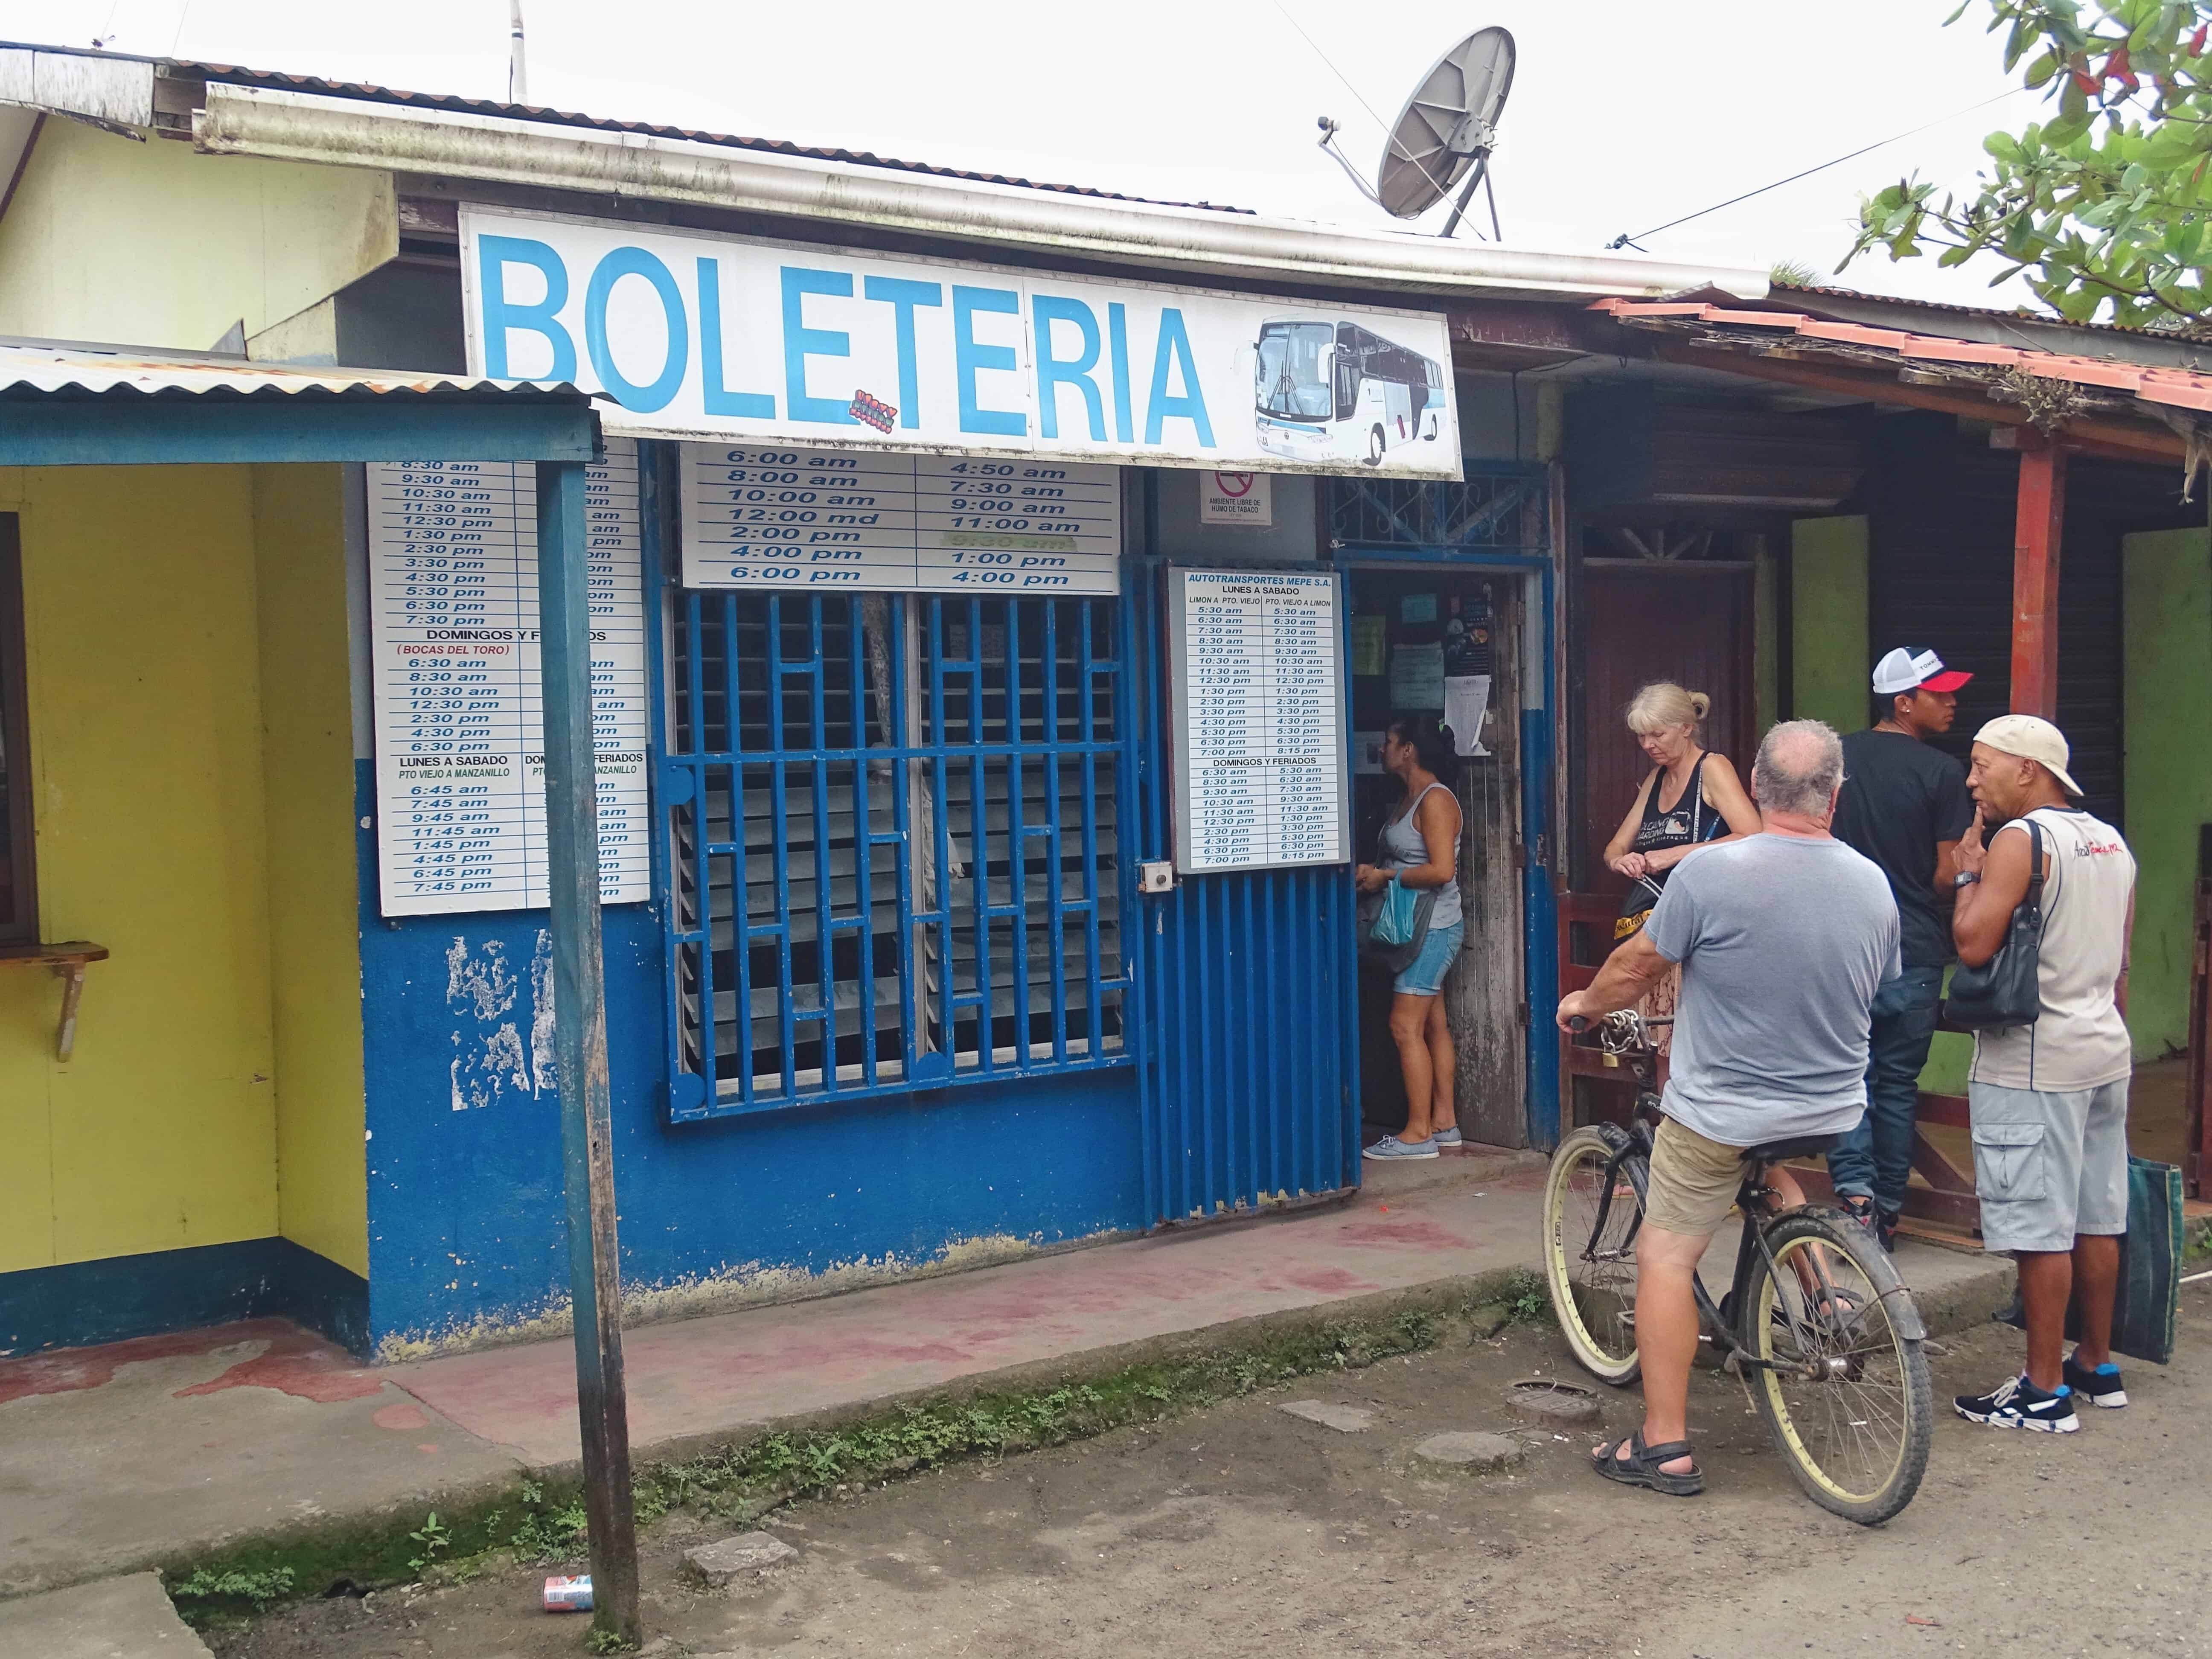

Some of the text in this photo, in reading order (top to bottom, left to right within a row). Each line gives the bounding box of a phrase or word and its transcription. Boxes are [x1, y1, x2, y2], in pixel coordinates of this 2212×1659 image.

[478, 234, 1217, 448] BOLETERIA
[727, 451, 857, 468] 6:00 am
[951, 463, 1065, 479] 4:50 am
[402, 474, 444, 484] 9:30
[728, 470, 858, 486] 8:00 am
[403, 488, 455, 498] 10:30
[951, 481, 1063, 497] 7:30 am
[729, 489, 875, 505] 10:00 am
[403, 503, 455, 512] 11:30
[951, 499, 1065, 514] 9:00 am
[404, 516, 456, 526] 12:30
[729, 509, 879, 524] 12:00 md
[952, 517, 1080, 532] 11:00 am
[404, 530, 445, 539] 1:30
[731, 527, 860, 543] 2:00 pm
[405, 544, 446, 553] 2:30
[731, 546, 862, 561] 4:00 pm
[405, 559, 447, 567] 3:30
[952, 552, 1065, 567] 1:00 pm
[405, 573, 448, 582] 4:30
[731, 567, 860, 582] 6:00 pm
[952, 572, 1068, 586] 4:00 pm
[1189, 574, 1284, 585] AUTOTRANSPORTES
[406, 587, 448, 596] 5:30
[406, 601, 448, 609] 6:30
[406, 615, 485, 626] 7:30 pm
[427, 630, 512, 640] DOMINGOS
[517, 631, 527, 640] Y
[398, 644, 444, 655] (BOCAS
[474, 645, 509, 655] TORO)
[409, 659, 450, 667] 6:30
[410, 673, 451, 681] 8:30
[410, 687, 463, 696] 10:30
[410, 701, 463, 709] 12:30
[411, 714, 489, 724] 2:30 pm
[411, 728, 490, 738] 4:30 pm
[411, 742, 452, 751] 6:30
[400, 756, 507, 766] LUNES A SABADO
[419, 770, 444, 778] VIEJO
[455, 768, 509, 777] MANZANILLO
[411, 786, 452, 795] 6:45
[412, 799, 452, 808] 7:45
[412, 813, 453, 822] 9:45
[413, 827, 464, 836] 11:45
[599, 835, 628, 844] pm
[413, 841, 490, 850] 1:45 pm
[413, 854, 492, 864] 4:45 pm
[414, 868, 492, 878] 6:45 pm
[414, 882, 492, 892] 7:45 pm
